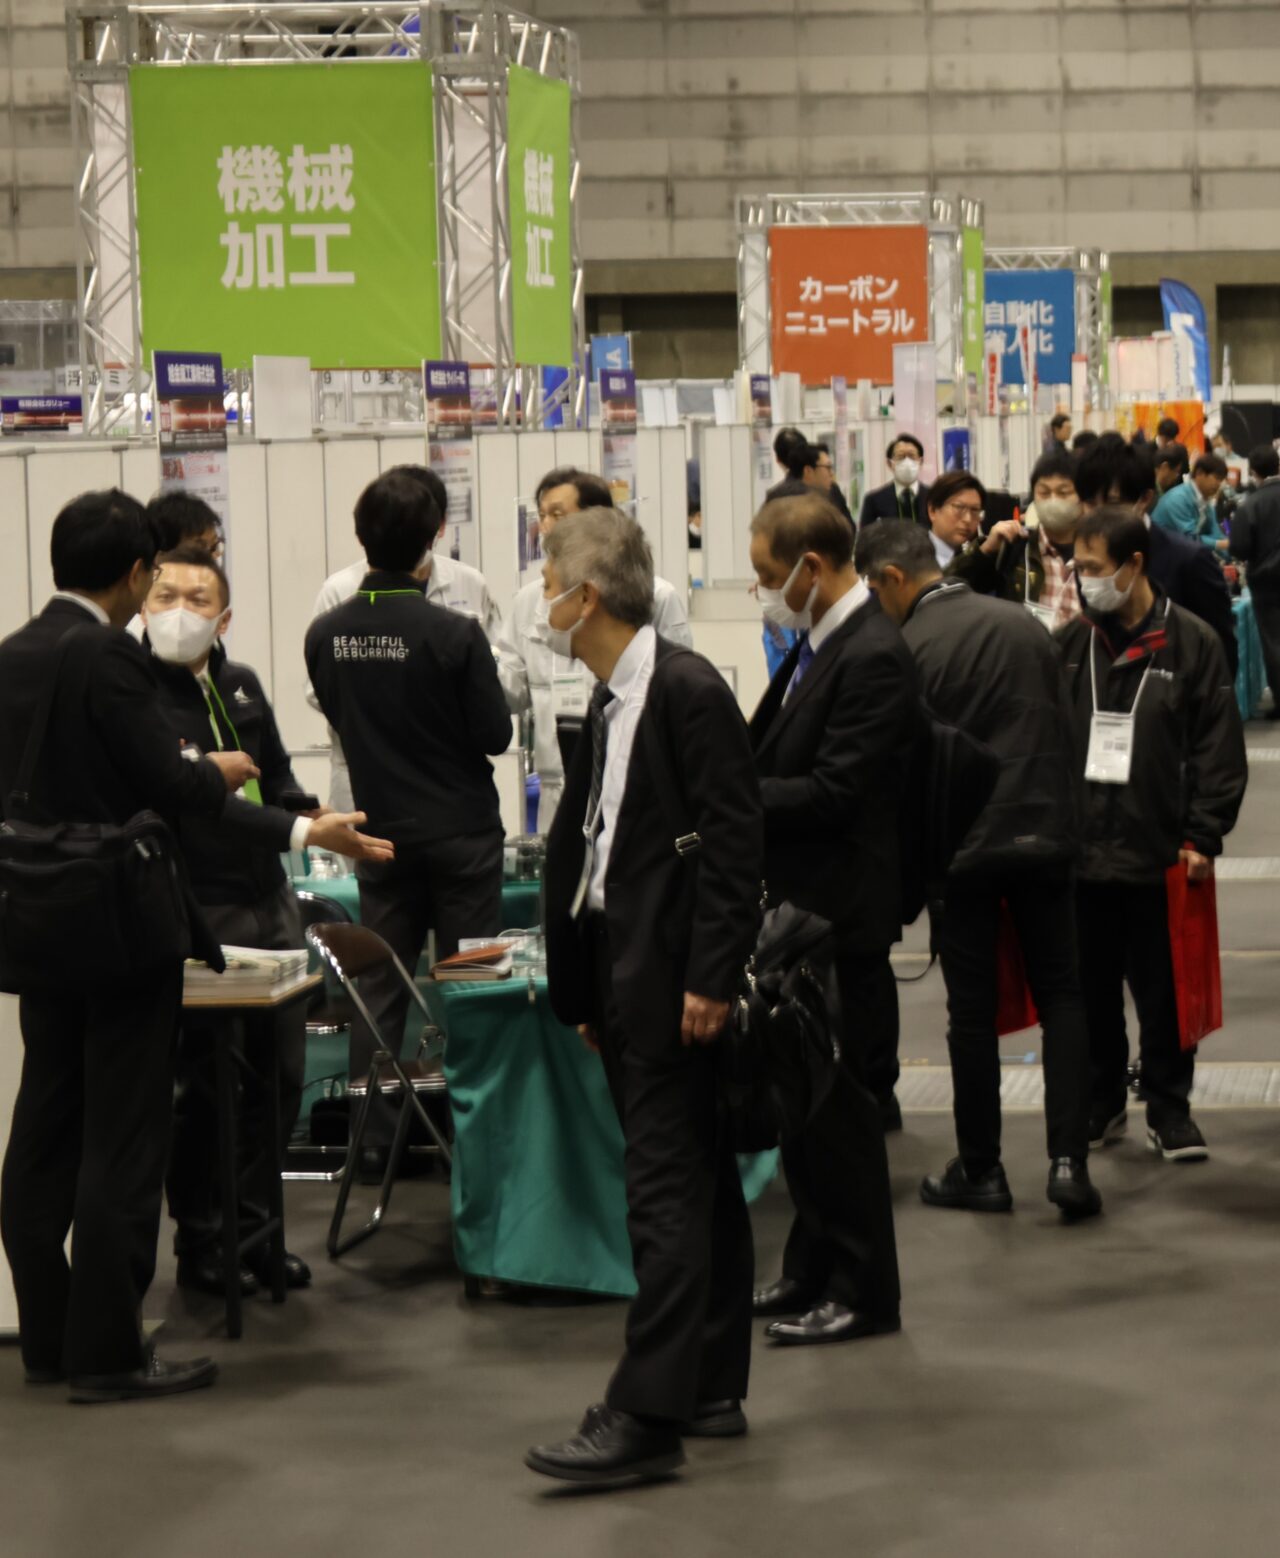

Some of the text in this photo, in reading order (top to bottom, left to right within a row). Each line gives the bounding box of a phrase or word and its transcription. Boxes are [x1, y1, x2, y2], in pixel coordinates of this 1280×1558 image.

[217, 144, 355, 214] 機械
[523, 148, 555, 218] 機械
[219, 222, 356, 290] 加工
[525, 228, 555, 288] 加工
[799, 275, 899, 303] カーボン
[784, 306, 914, 338] ニュートラル
[333, 636, 404, 647] BEAUTIFUL
